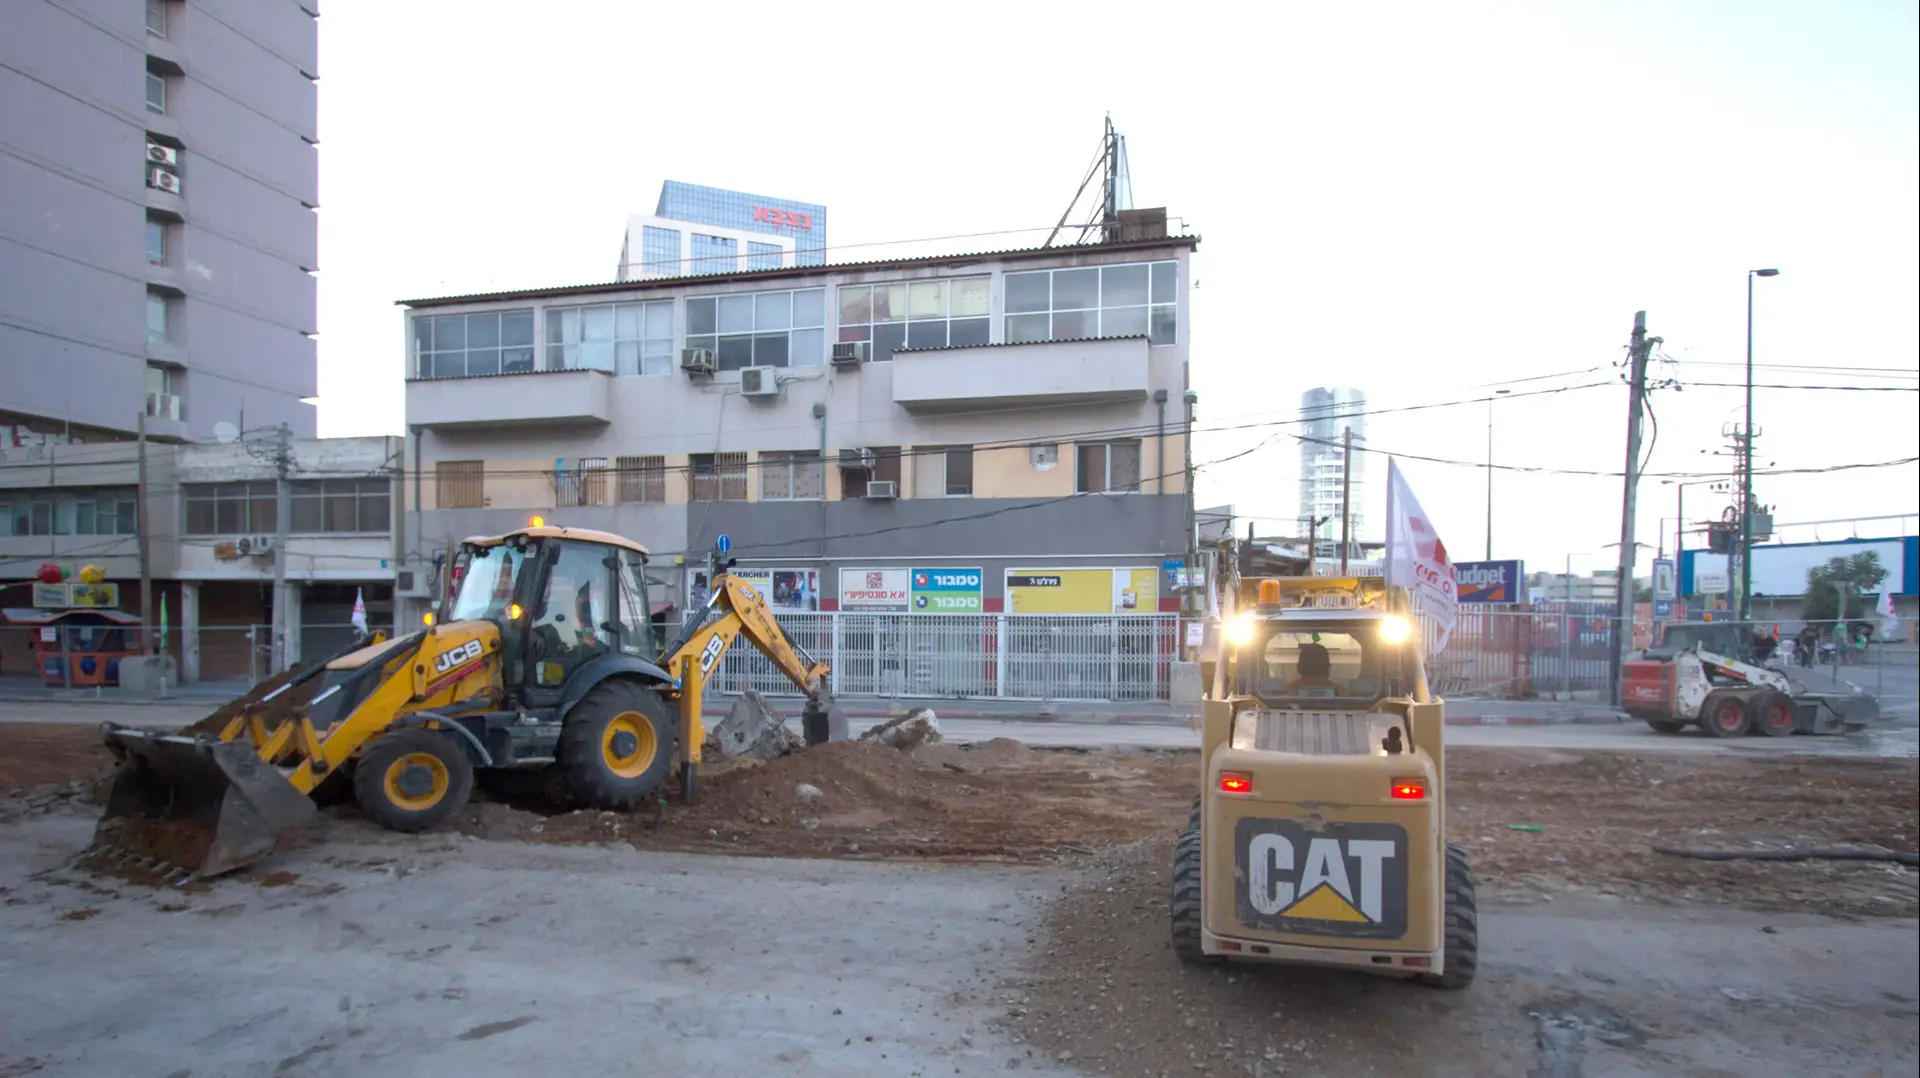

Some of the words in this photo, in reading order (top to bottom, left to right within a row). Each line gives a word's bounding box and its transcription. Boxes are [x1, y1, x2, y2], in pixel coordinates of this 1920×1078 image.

[933, 575, 979, 586] טמבור
[1456, 564, 1507, 590] udget
[933, 596, 979, 608] טמבור
[436, 639, 483, 672] JCB
[701, 632, 726, 680] CB
[1249, 833, 1395, 923] CAT
